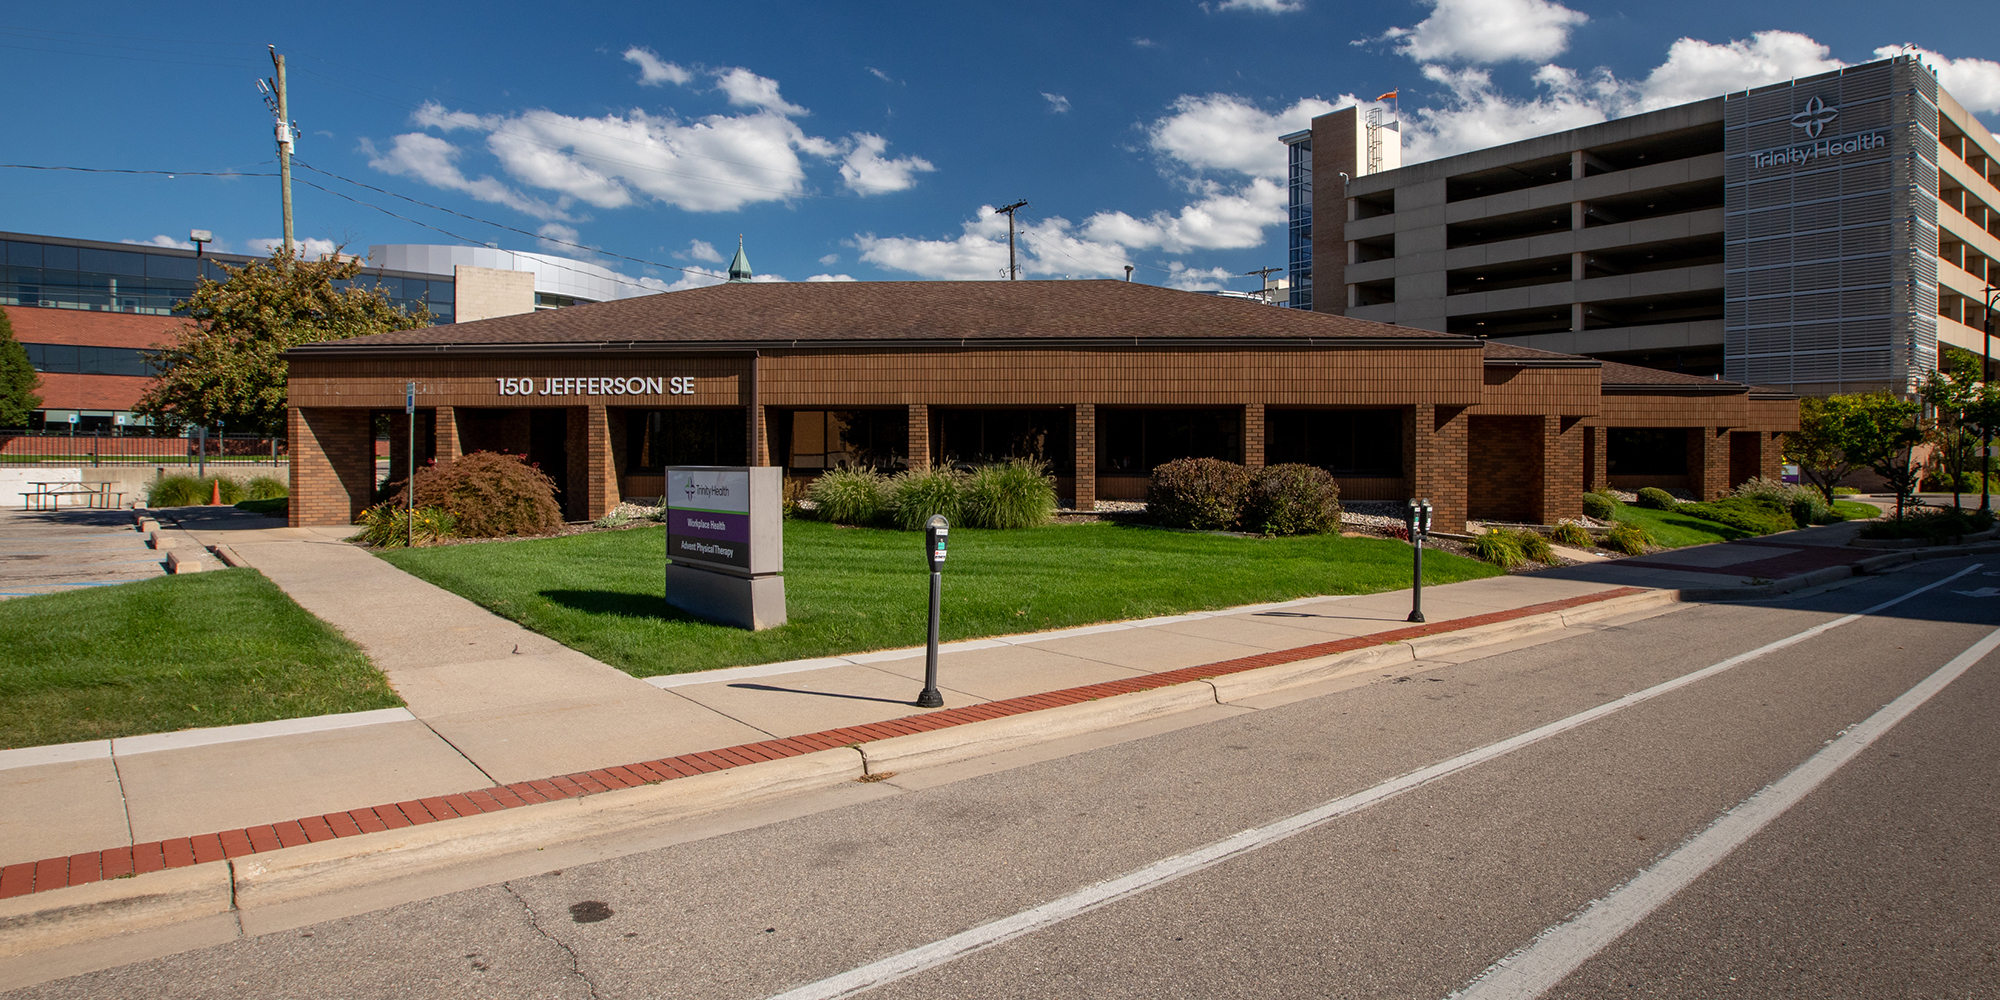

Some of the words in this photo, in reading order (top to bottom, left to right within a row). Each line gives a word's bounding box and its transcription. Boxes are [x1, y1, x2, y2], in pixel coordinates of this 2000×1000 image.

[1750, 147, 1811, 169] Trinity
[1814, 132, 1886, 159] Health
[496, 377, 534, 396] 150
[539, 376, 663, 396] JEFFERSON
[669, 376, 695, 395] SE
[696, 485, 711, 498] Trinity
[712, 485, 729, 496] Health
[687, 518, 709, 529] Workplace
[710, 520, 725, 530] Health
[681, 540, 696, 550] Advent
[697, 542, 714, 554] Physical
[714, 545, 733, 558] Therapy
